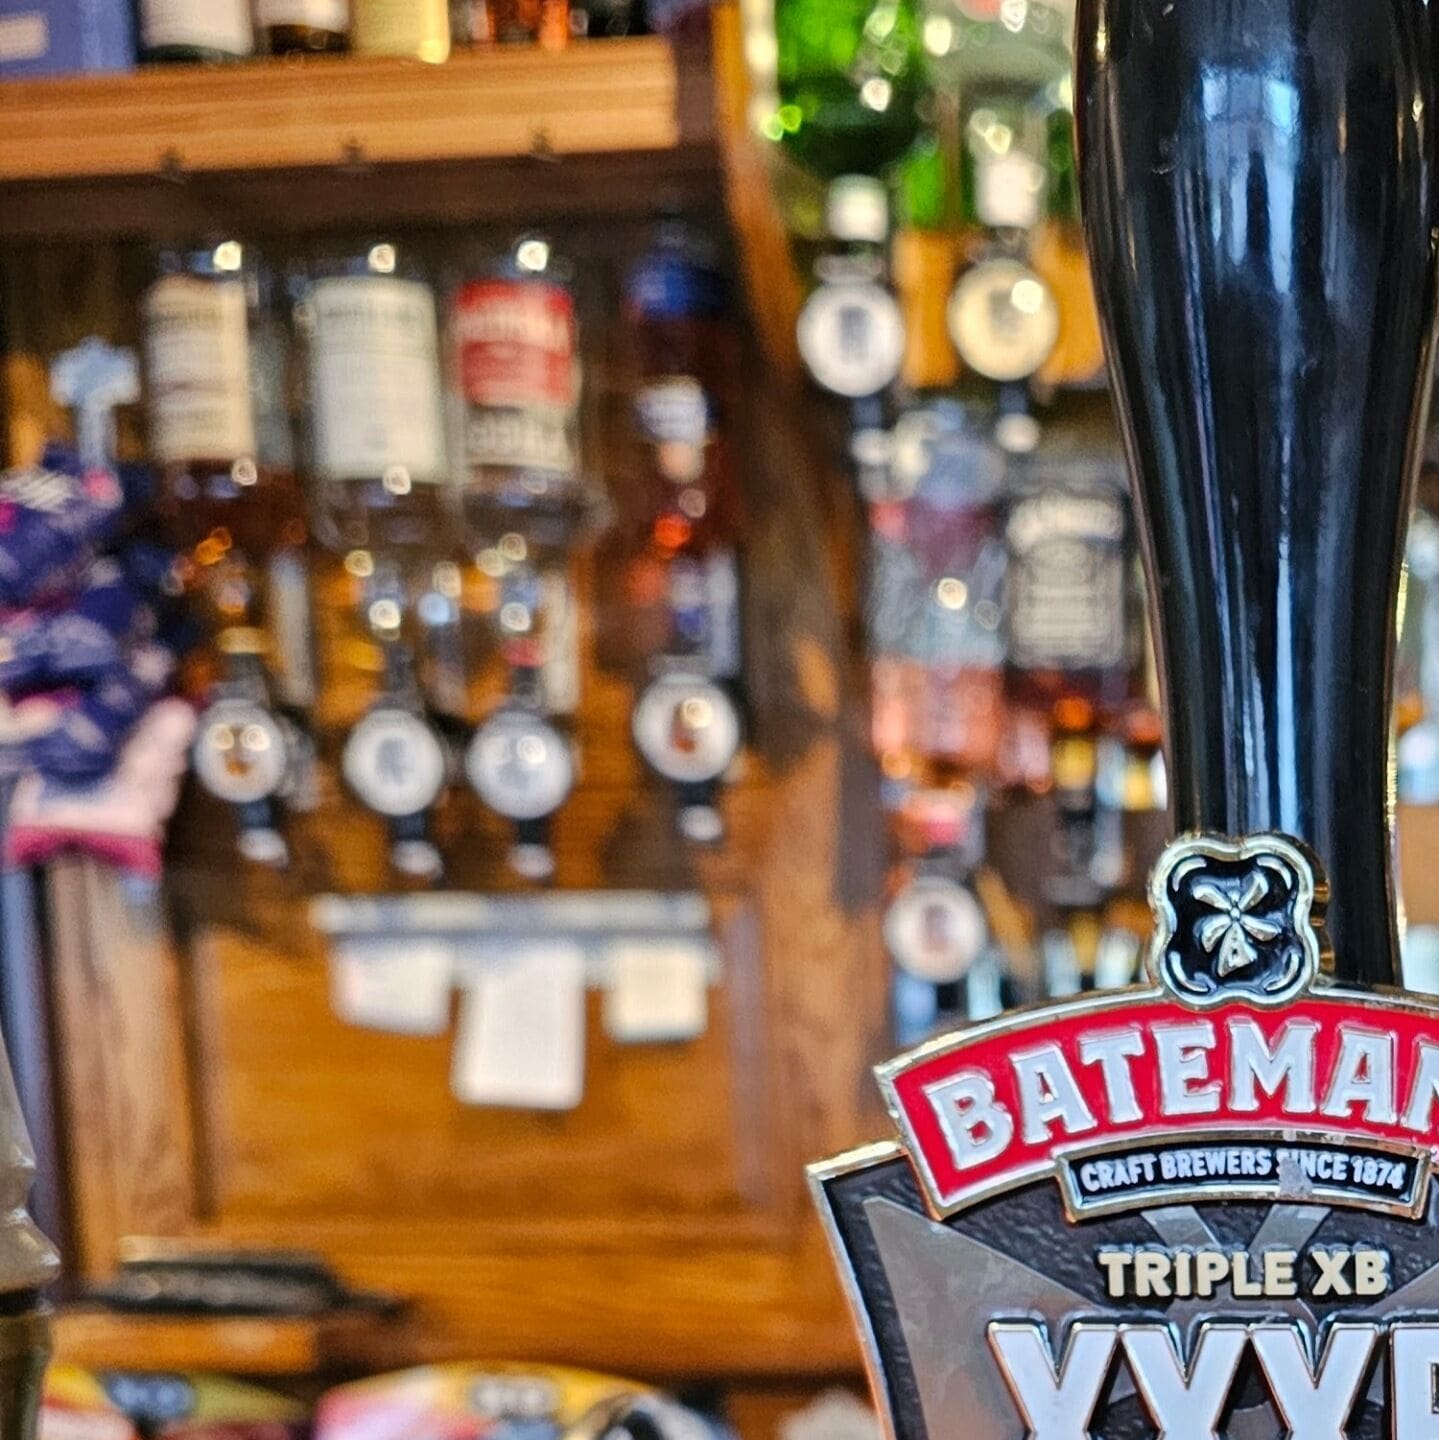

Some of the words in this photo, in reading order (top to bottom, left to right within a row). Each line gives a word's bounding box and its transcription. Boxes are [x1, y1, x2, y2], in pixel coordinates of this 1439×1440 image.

[1080, 1153, 1158, 1193] CRAFT
[1158, 1149, 1275, 1180] BREWERS
[1353, 1158, 1408, 1190] 1874
[1098, 1244, 1299, 1298] TRIPLE
[1310, 1244, 1390, 1296] XB
